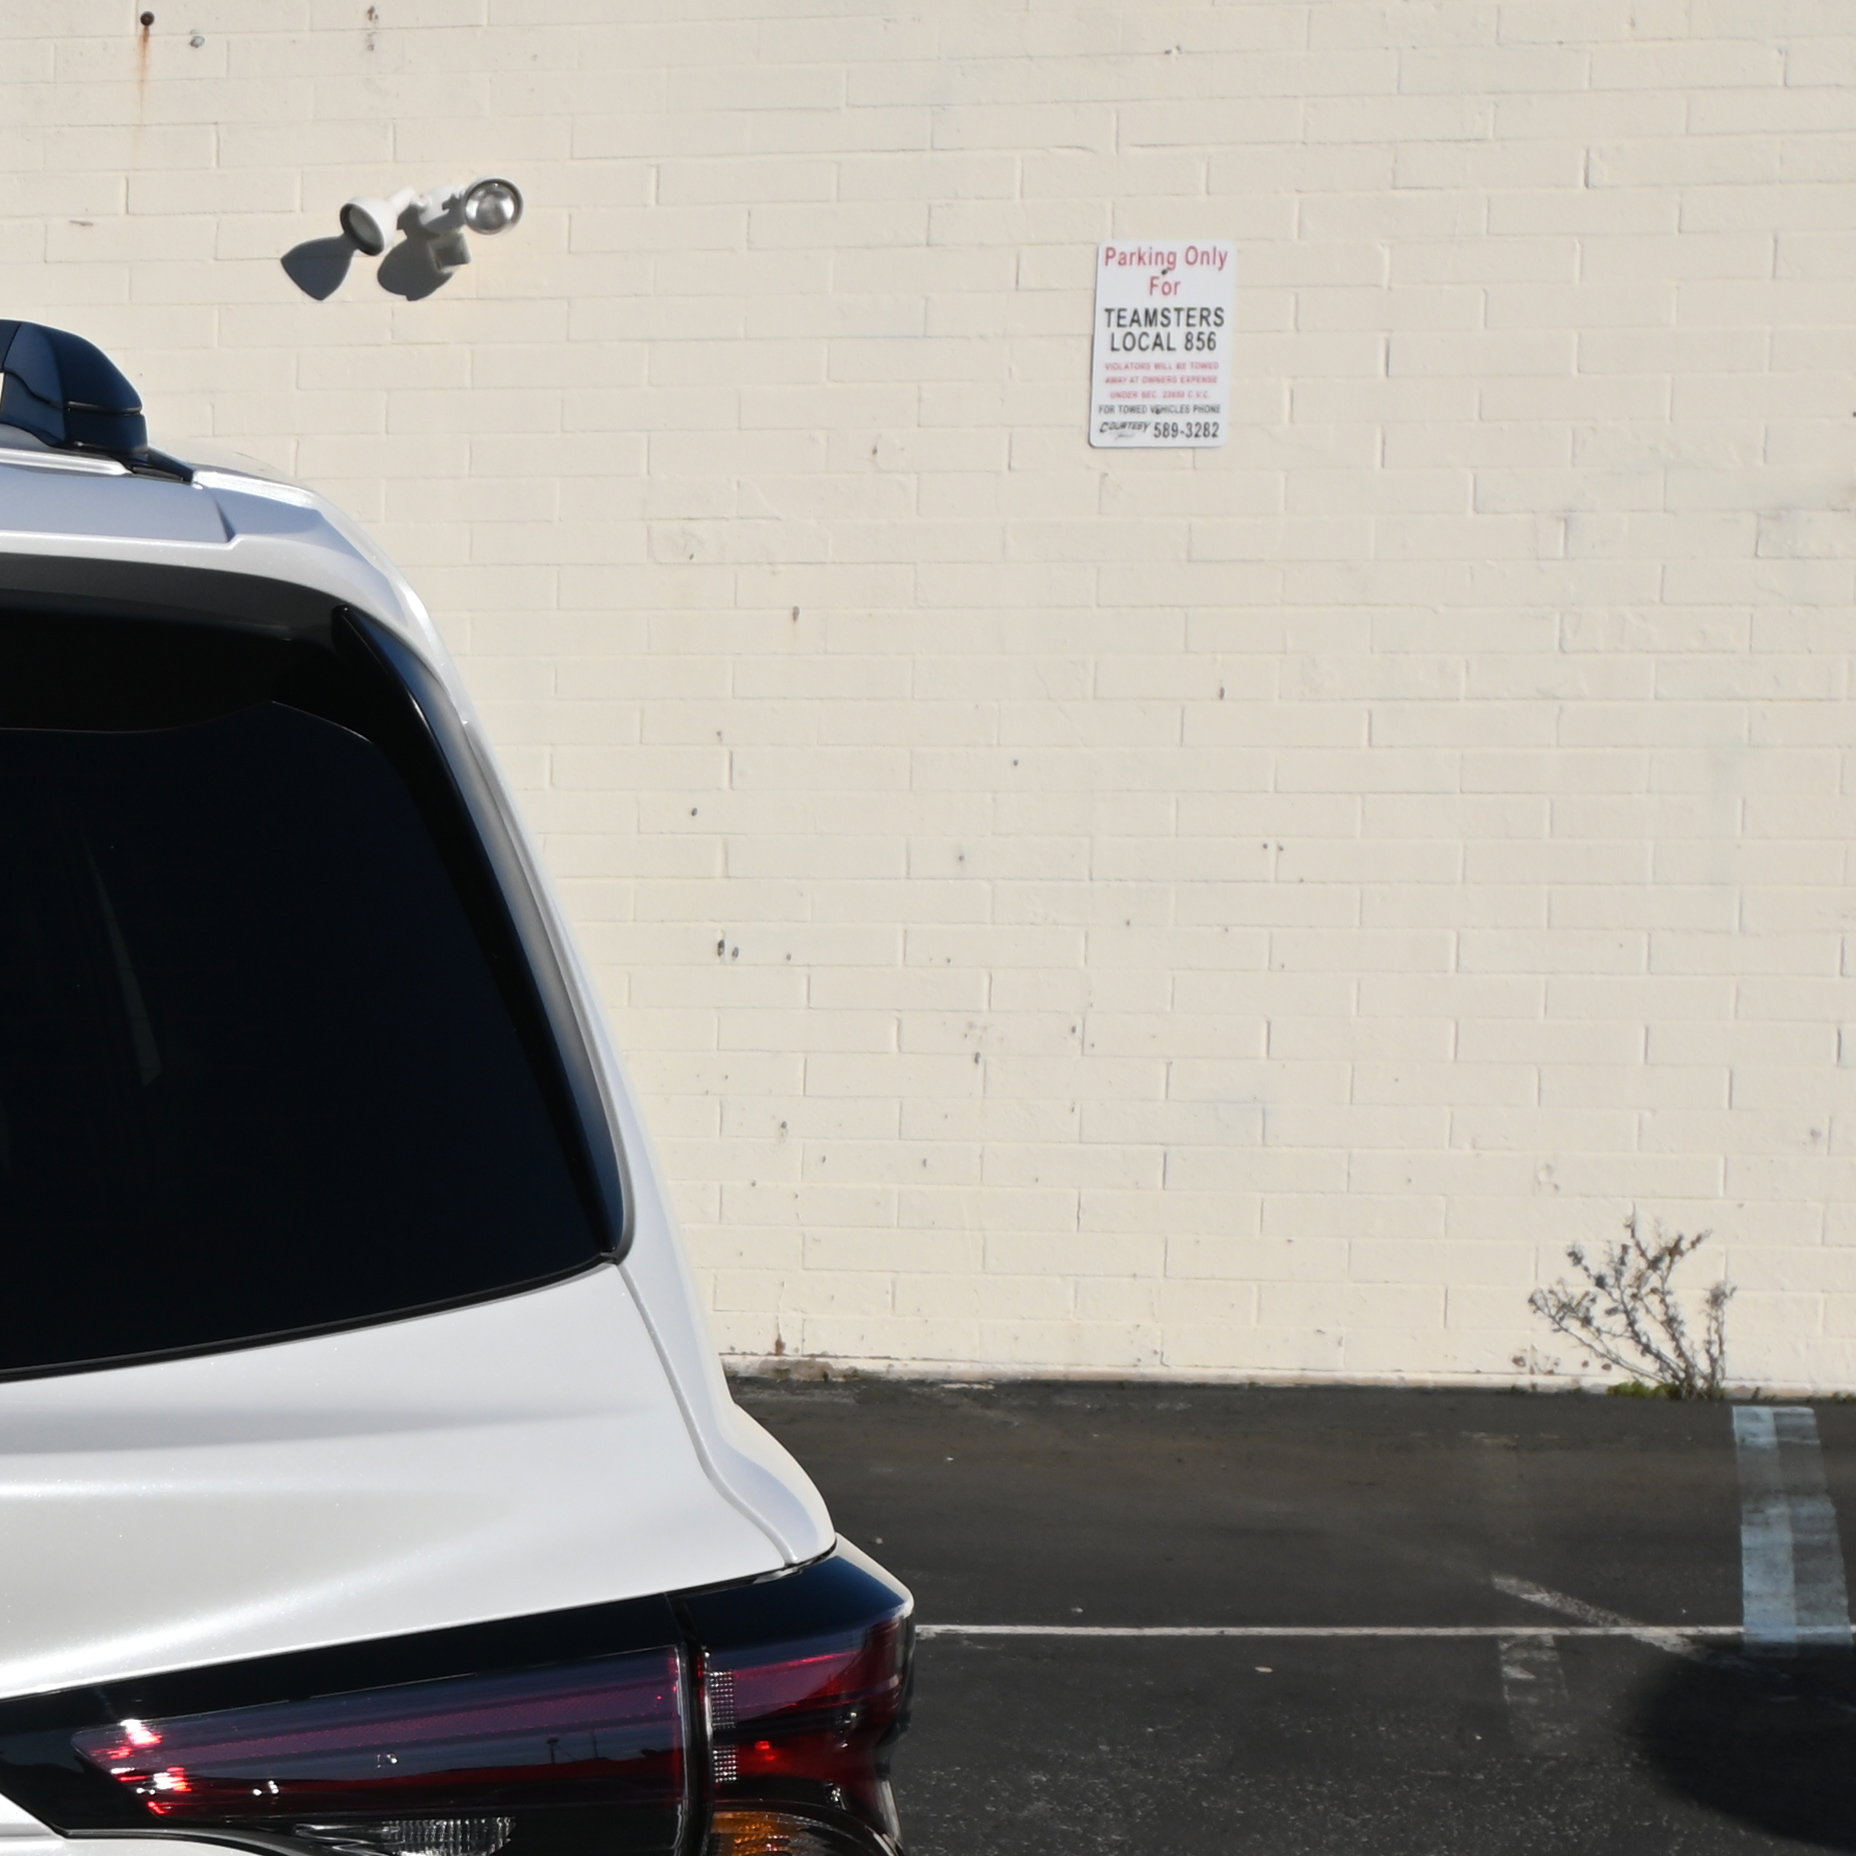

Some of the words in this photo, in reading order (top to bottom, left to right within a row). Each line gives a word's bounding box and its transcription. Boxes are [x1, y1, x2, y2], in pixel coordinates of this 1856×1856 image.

[1104, 246, 1177, 271] Parking
[1184, 245, 1228, 270] Only
[1149, 275, 1181, 296] For
[1104, 307, 1225, 328] TEAMSTERS
[1110, 331, 1176, 352] LOCAL
[1184, 331, 1217, 351] 856
[1099, 404, 1115, 414] FOR
[1119, 404, 1147, 414] TOWED
[1150, 404, 1190, 414] VEHICLES
[1193, 404, 1221, 414] PHONE
[1153, 421, 1220, 438] 589-3282
